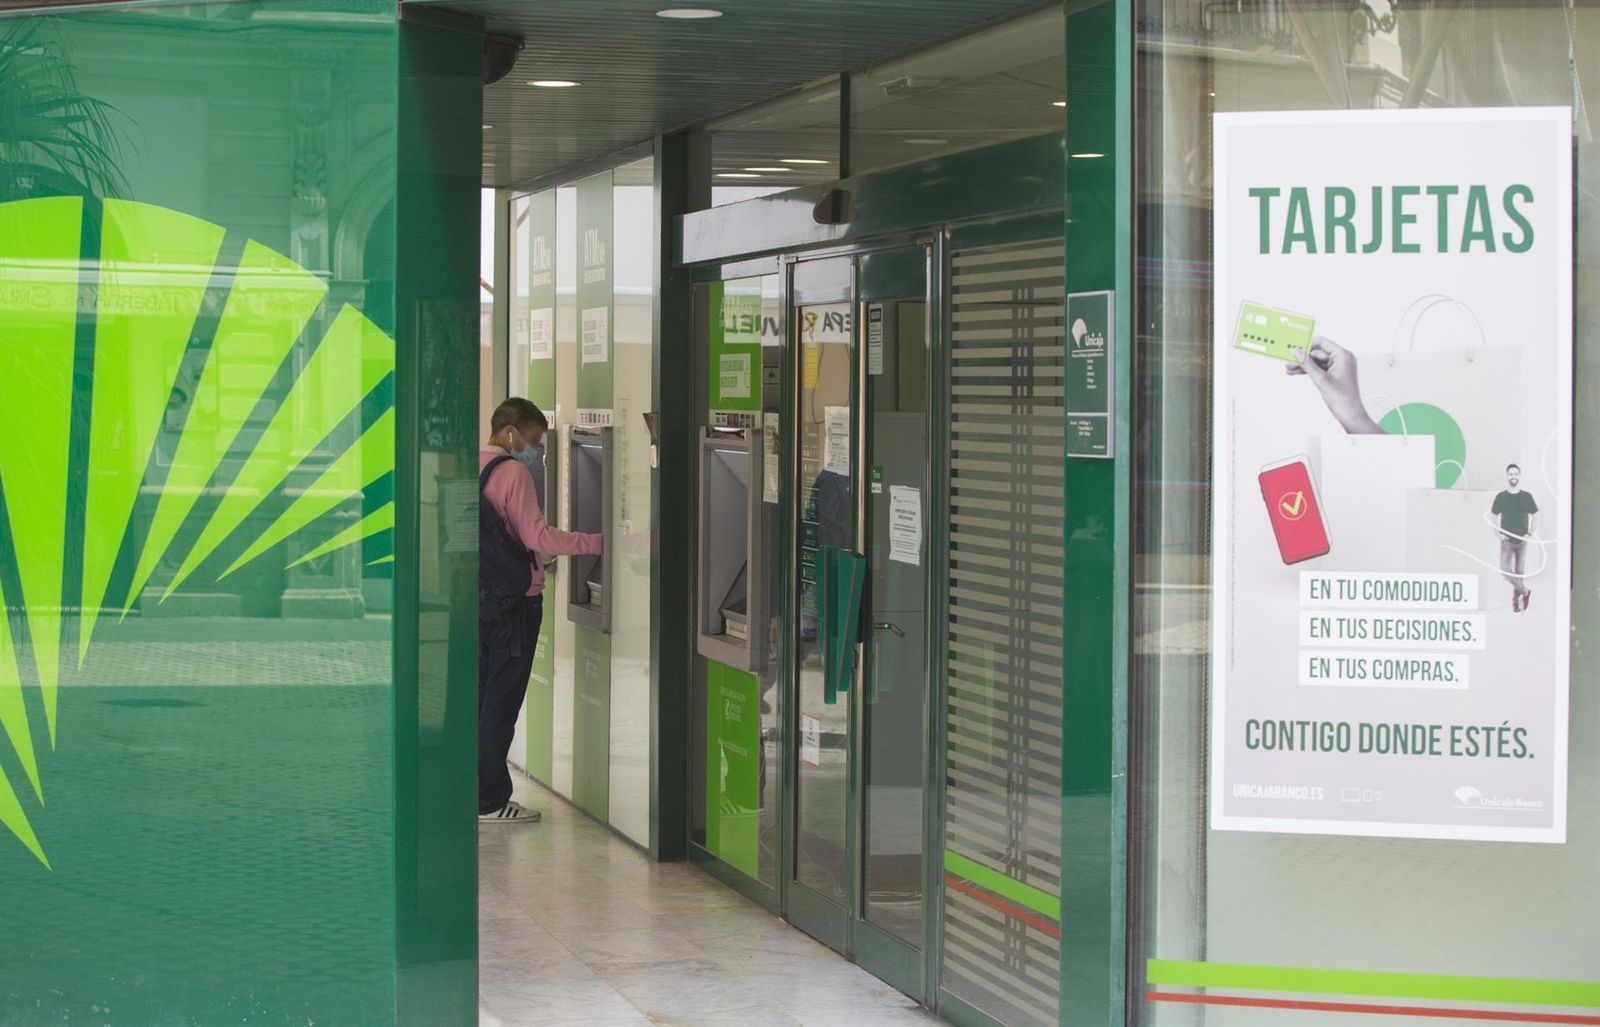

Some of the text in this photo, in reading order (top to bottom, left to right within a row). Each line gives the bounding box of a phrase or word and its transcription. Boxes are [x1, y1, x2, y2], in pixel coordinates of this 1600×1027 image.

[1249, 184, 1534, 254] TARJETAS
[1309, 578, 1468, 603] EN TU COMODIDAD.
[1309, 617, 1477, 642] EN TUS DECISIONES.
[1309, 657, 1459, 682] EN TUS COMPRAS.
[1245, 718, 1535, 759] CONTIGO DONDE ESTÉS.
[1232, 783, 1324, 801] UNICAJABANCO.ES
[1479, 796, 1545, 808] Unicaja Banco
